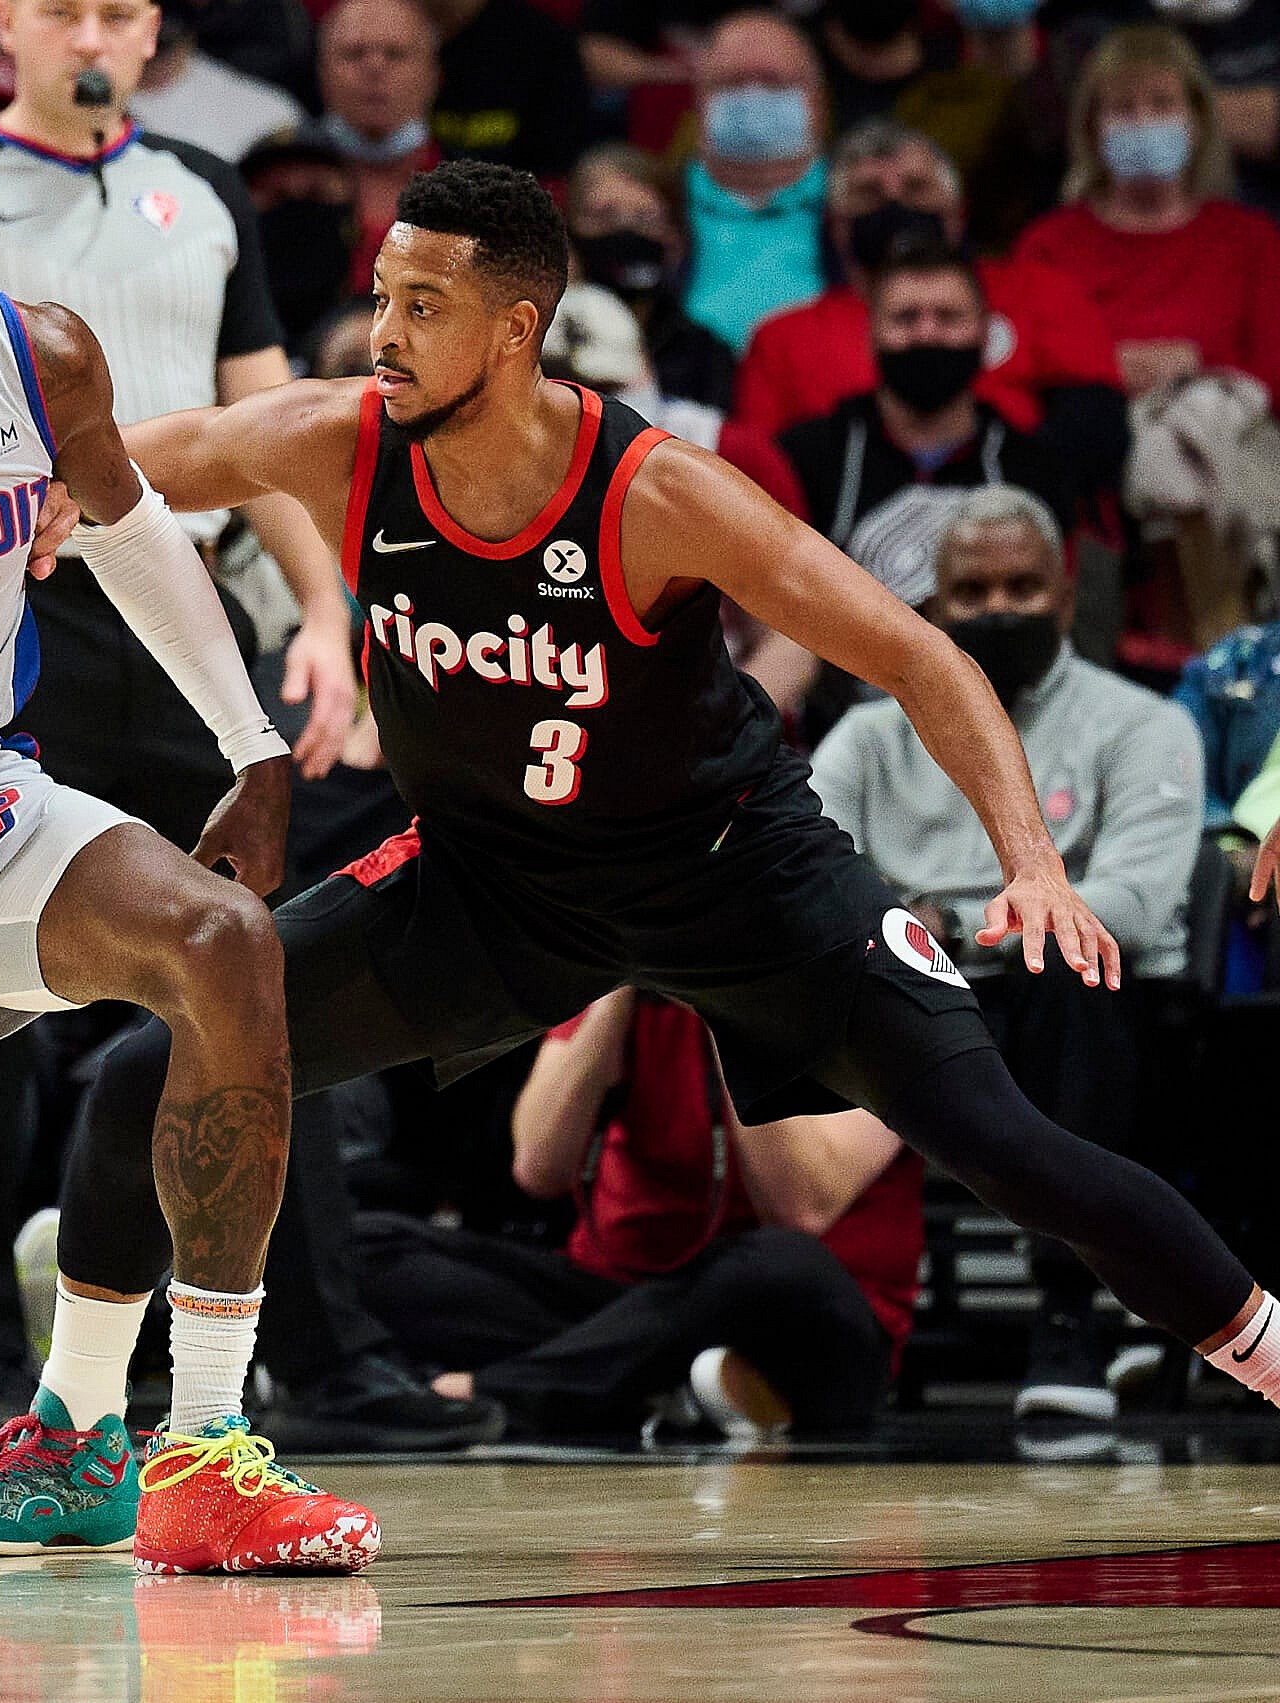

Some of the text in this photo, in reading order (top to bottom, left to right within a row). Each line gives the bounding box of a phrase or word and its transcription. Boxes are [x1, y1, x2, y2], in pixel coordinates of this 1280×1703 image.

[537, 582, 595, 600] StormX
[370, 592, 609, 709] ripcity
[523, 719, 589, 806] 3
